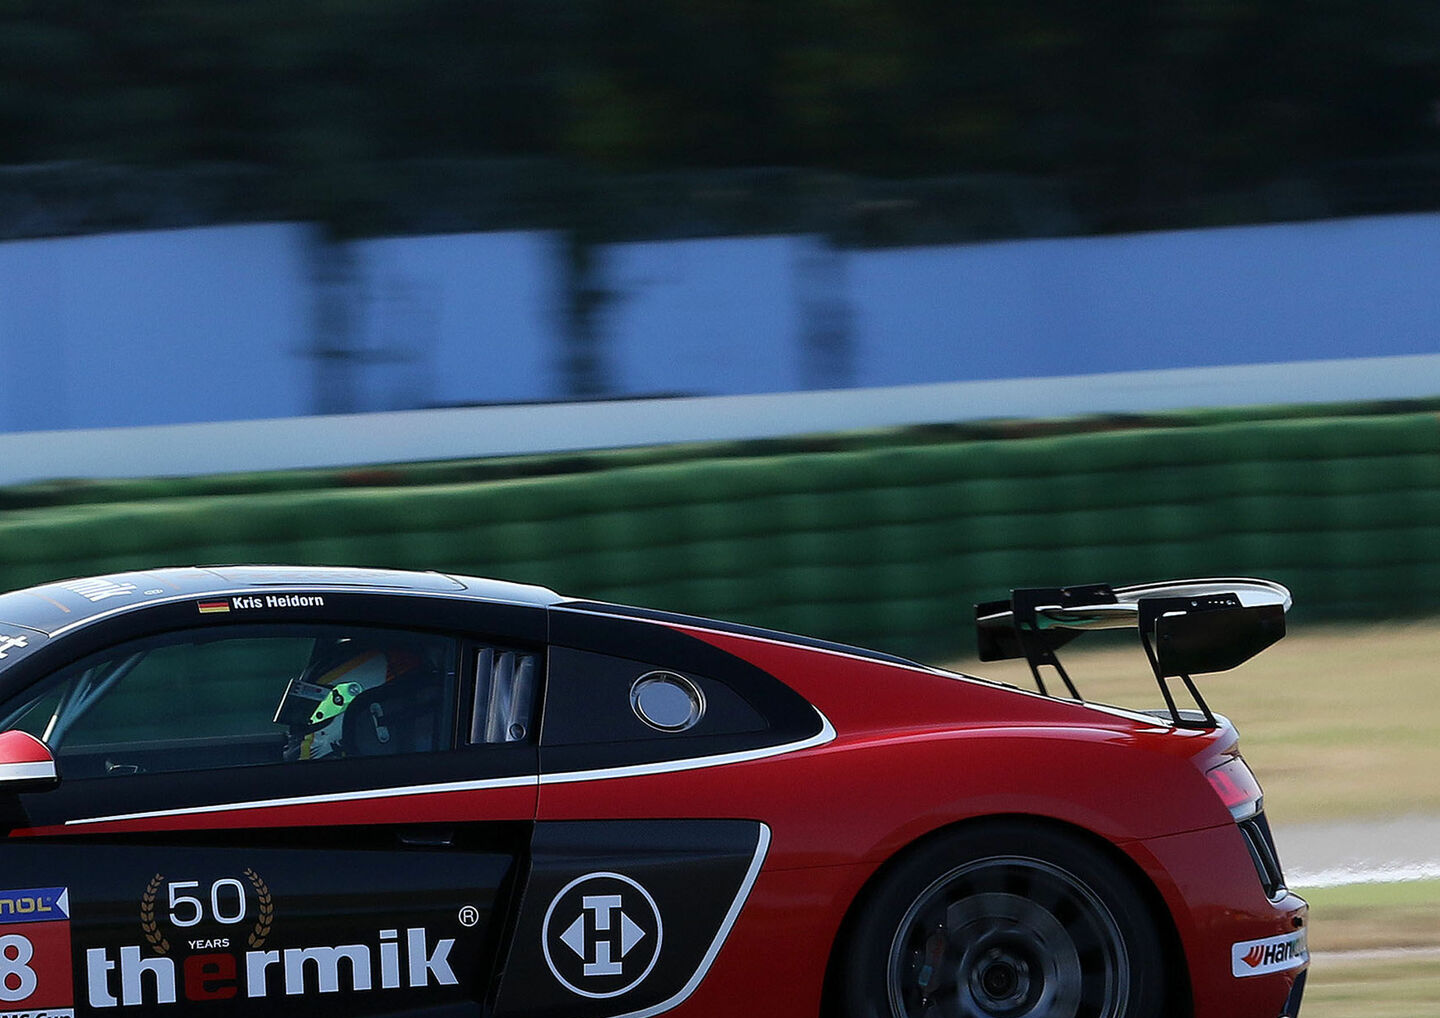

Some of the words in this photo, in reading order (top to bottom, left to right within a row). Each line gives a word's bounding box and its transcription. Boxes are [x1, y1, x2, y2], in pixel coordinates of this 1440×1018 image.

[232, 597, 263, 609] Kris
[266, 595, 324, 608] Heidorn
[168, 877, 246, 927] 50
[188, 938, 230, 950] YEARS
[86, 927, 459, 1008] thermik
